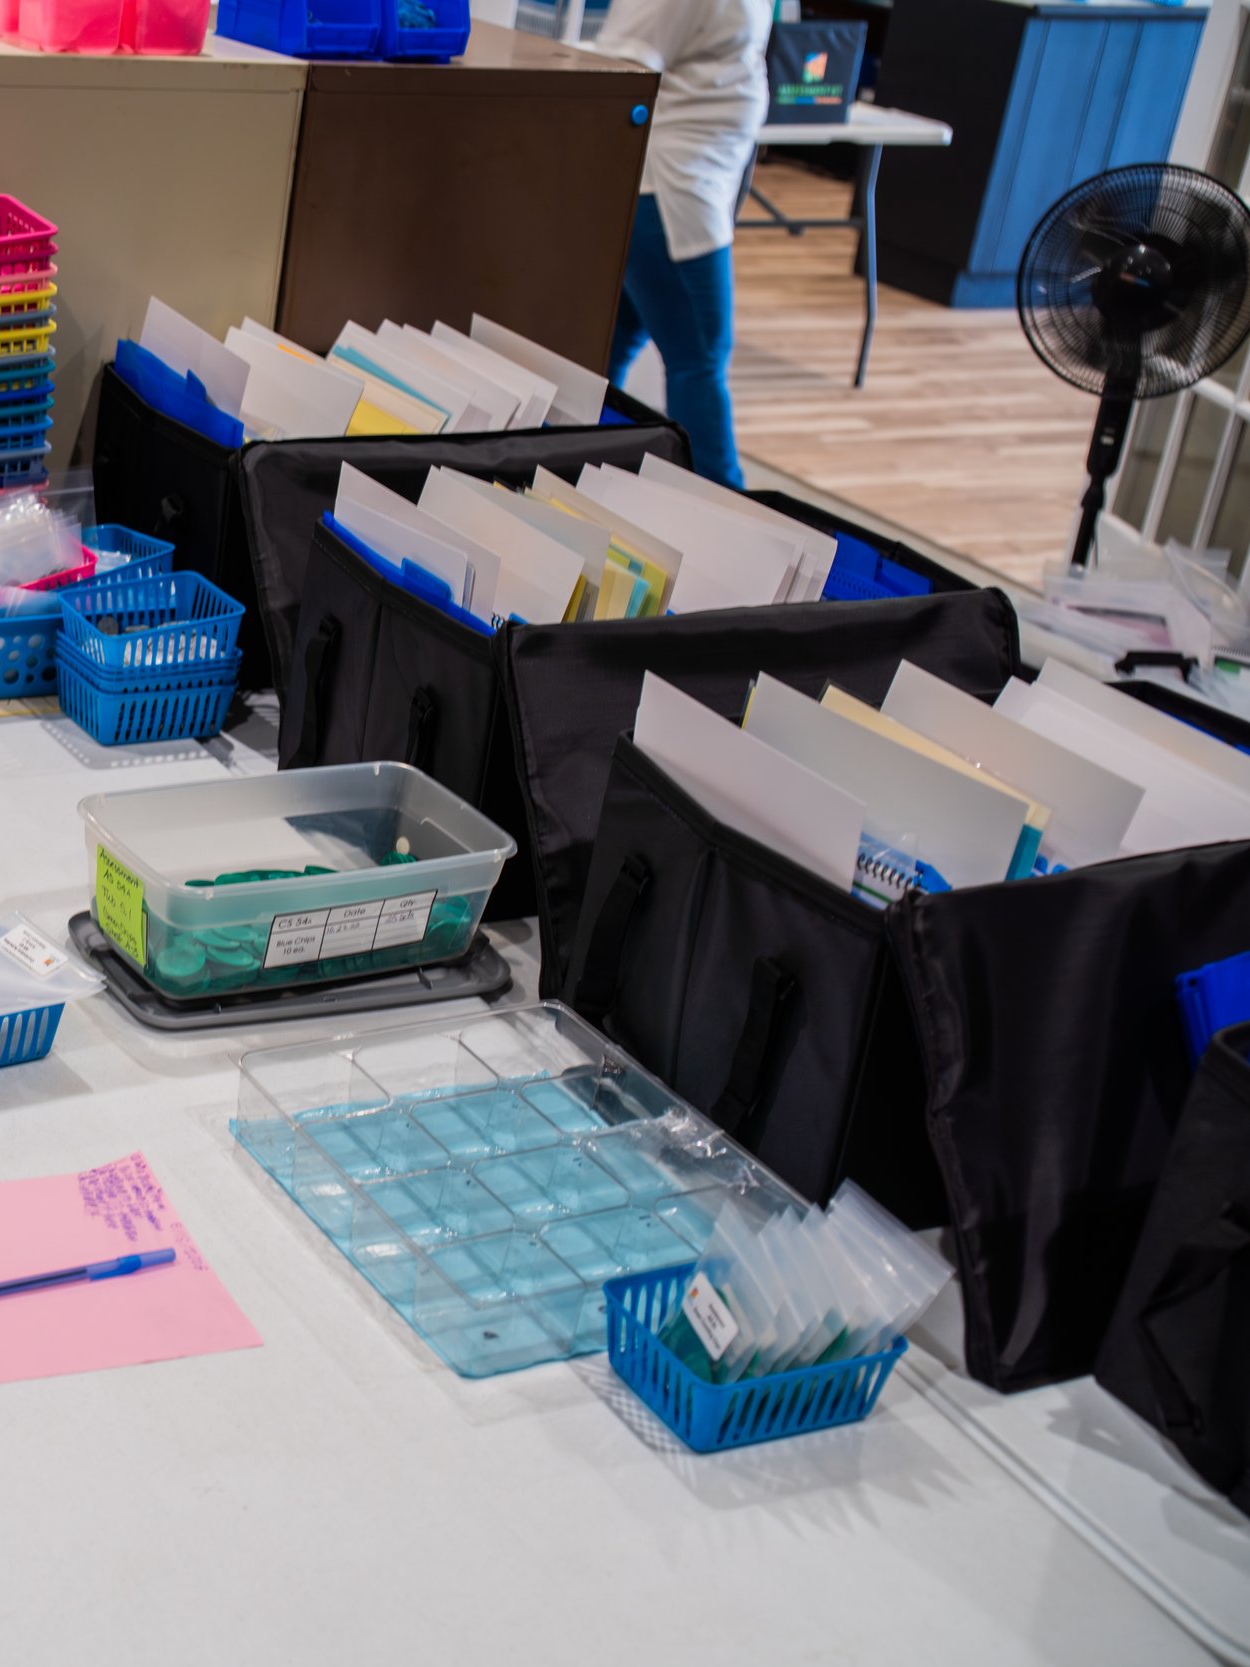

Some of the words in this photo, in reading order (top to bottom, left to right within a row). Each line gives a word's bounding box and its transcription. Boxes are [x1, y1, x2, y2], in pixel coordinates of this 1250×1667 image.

[344, 907, 366, 918] Date
[278, 918, 293, 929] CS
[277, 938, 293, 948] Blue
[295, 936, 316, 946] Chips
[283, 947, 292, 955] 10
